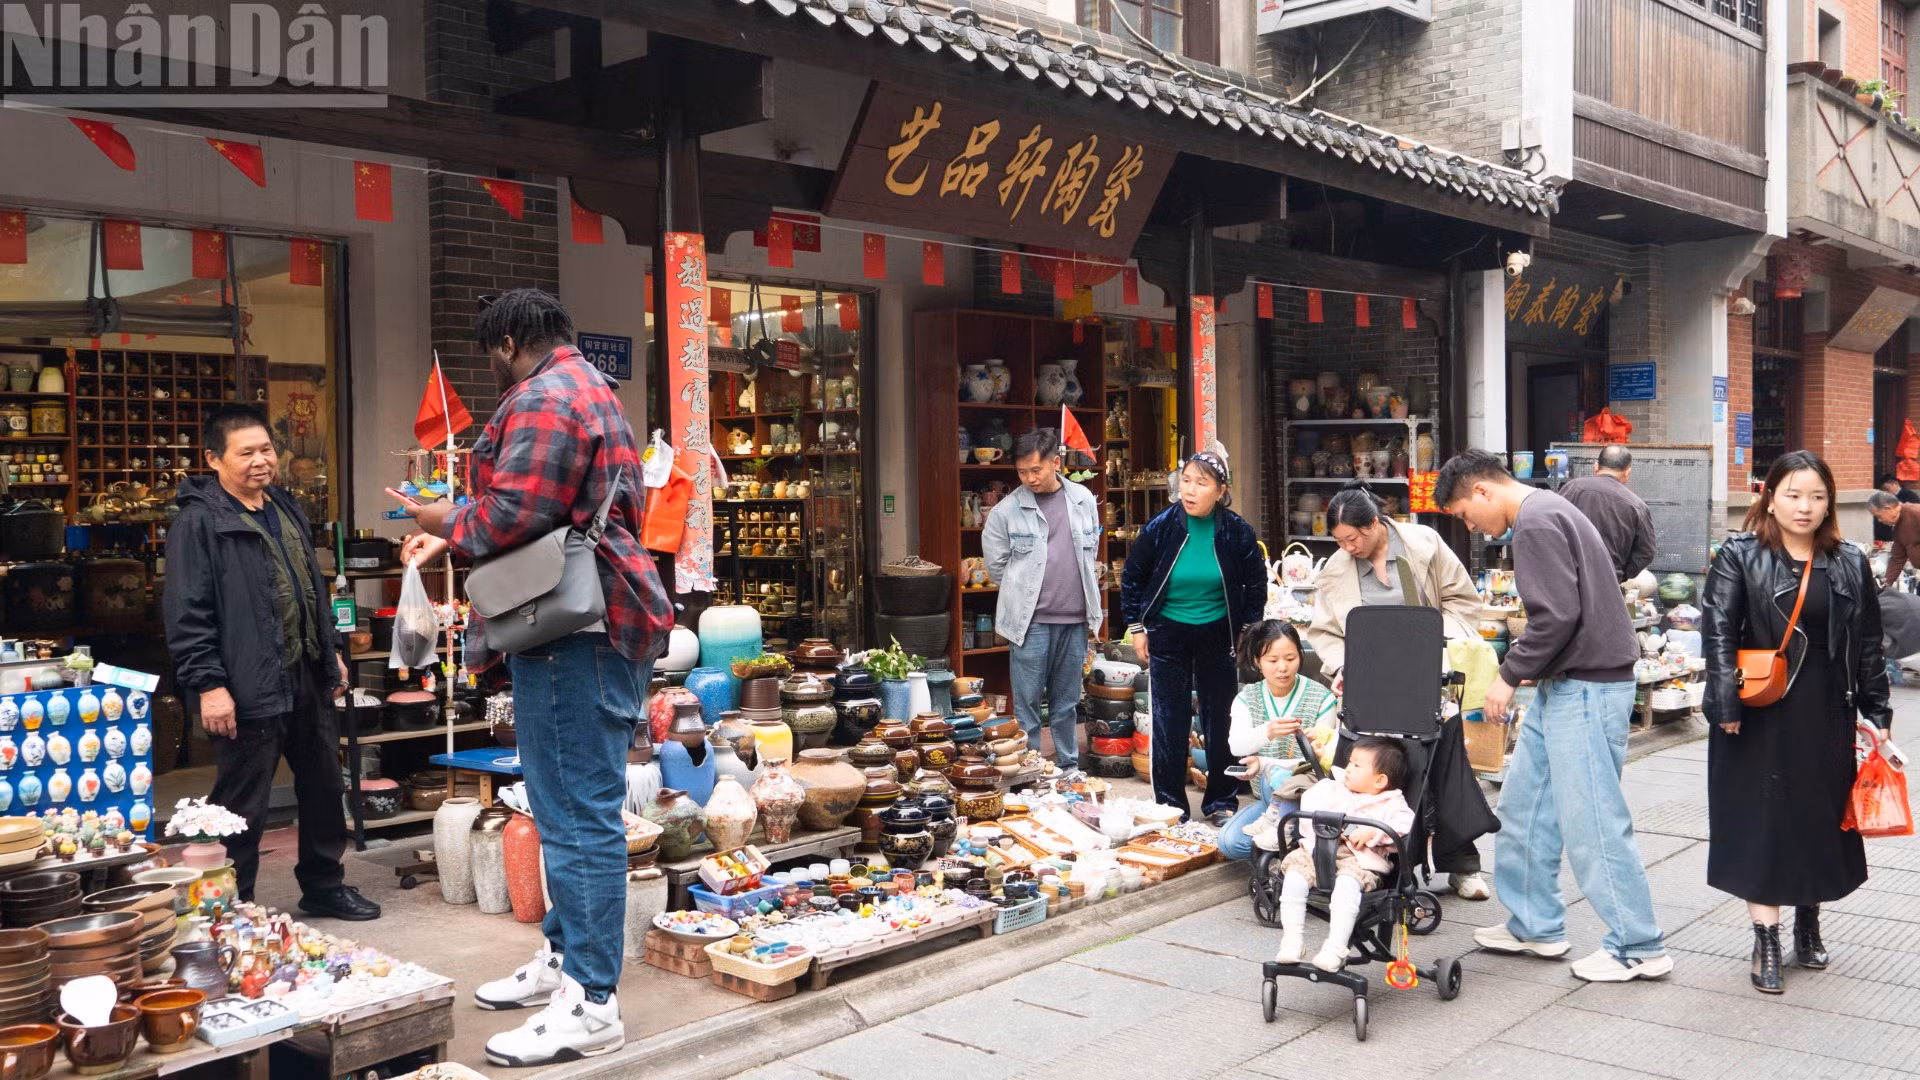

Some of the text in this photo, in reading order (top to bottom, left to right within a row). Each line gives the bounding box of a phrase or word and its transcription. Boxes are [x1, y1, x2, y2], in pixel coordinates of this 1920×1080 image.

[884, 101, 1143, 238] 艺品轩陶瓷
[587, 352, 617, 373] 268
